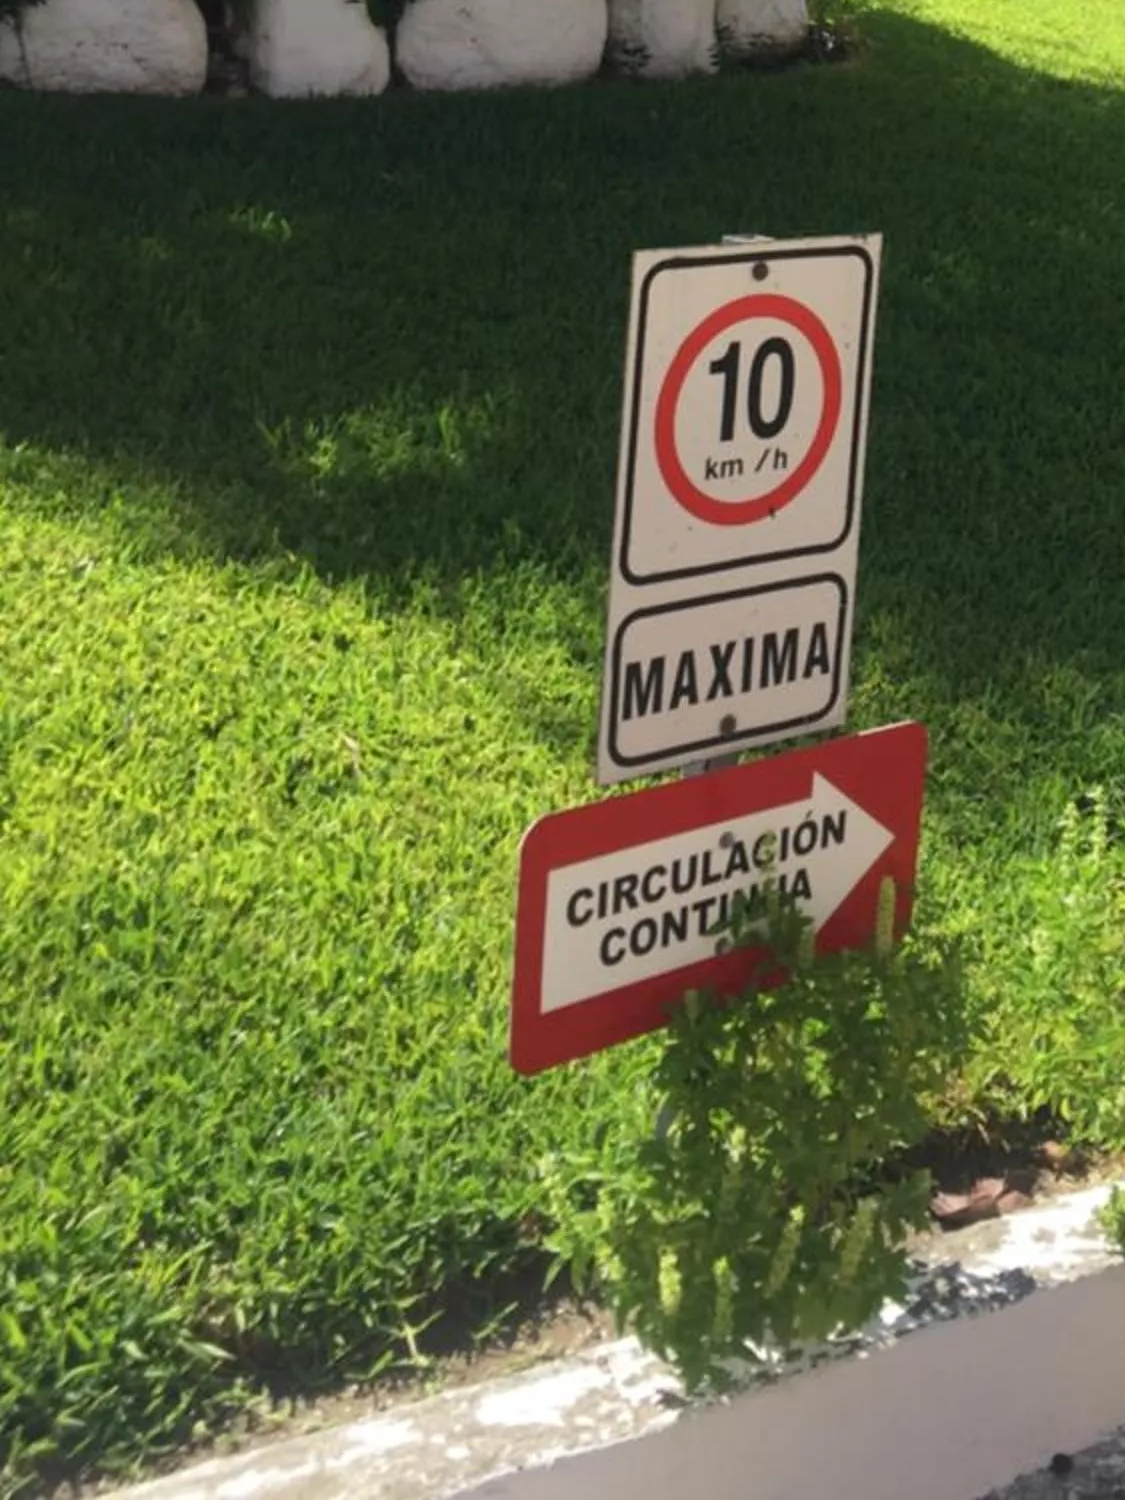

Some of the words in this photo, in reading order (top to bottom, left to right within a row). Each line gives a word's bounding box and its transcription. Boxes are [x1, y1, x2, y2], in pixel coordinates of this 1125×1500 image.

[710, 336, 794, 441] 10
[622, 622, 830, 720] MAXIMA
[566, 809, 847, 927] CIRCULACIÓN
[599, 868, 812, 966] CONTIA
